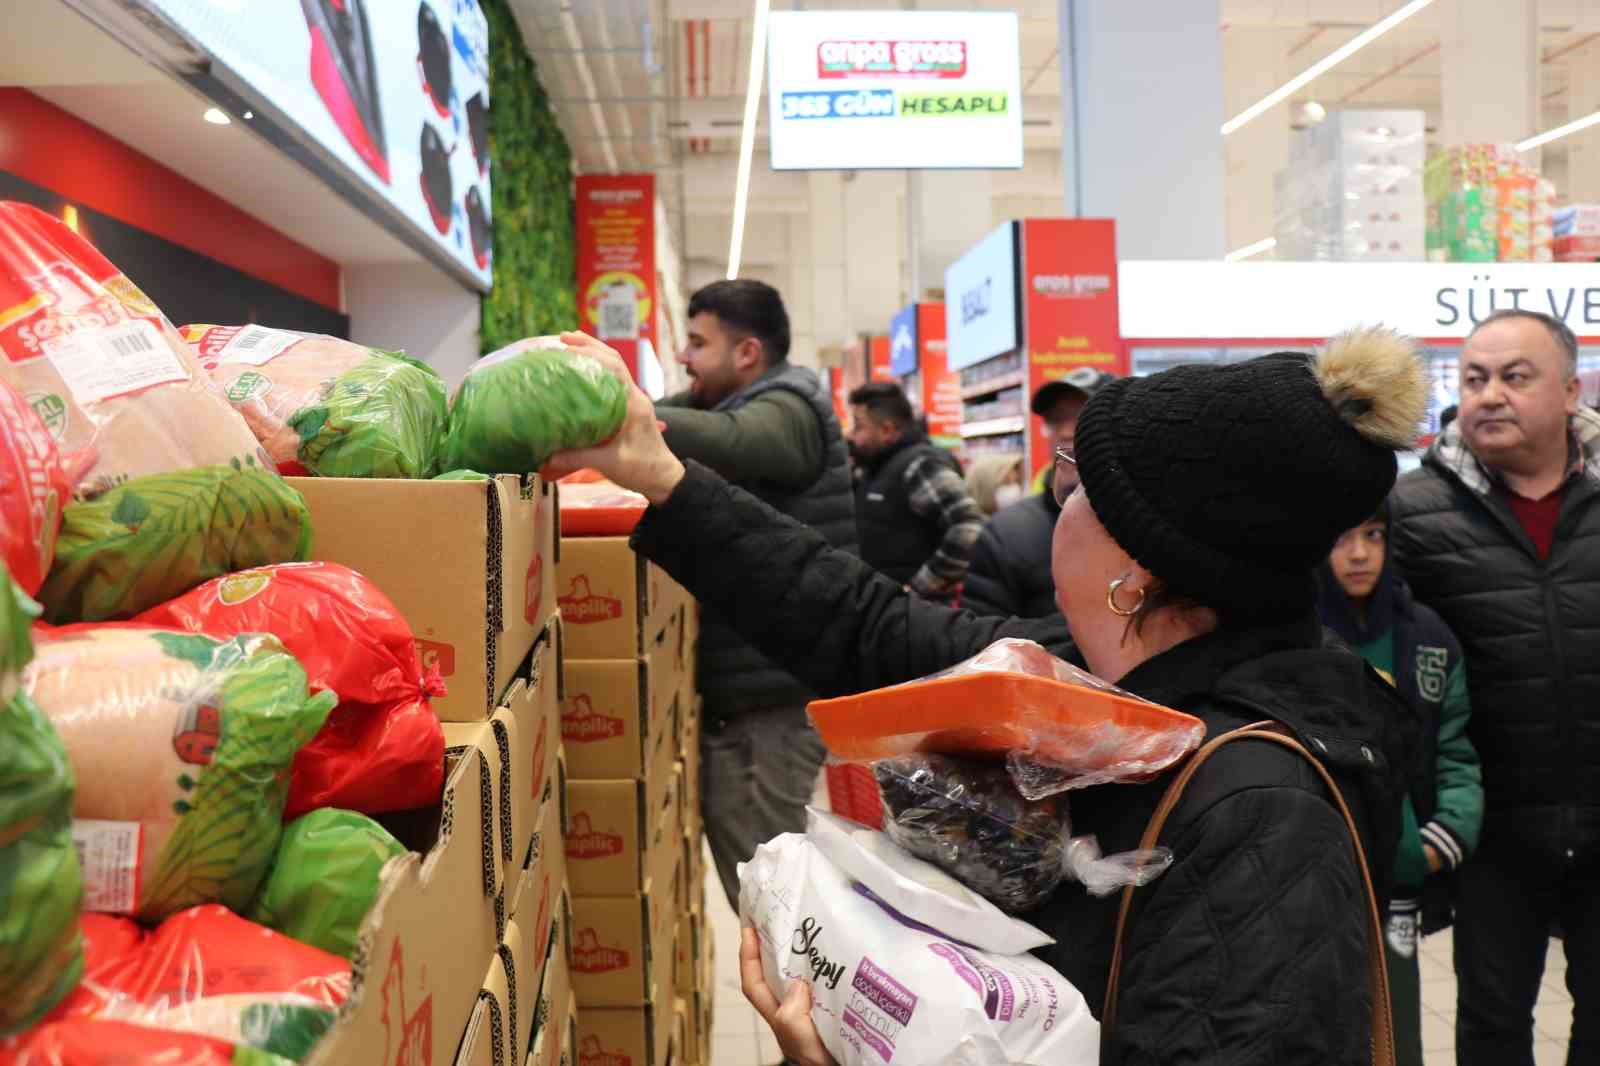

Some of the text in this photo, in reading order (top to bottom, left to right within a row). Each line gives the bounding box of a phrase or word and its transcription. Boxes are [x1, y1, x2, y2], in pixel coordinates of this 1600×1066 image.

[834, 90, 893, 117] GÜN
[901, 96, 1007, 115] HESAPLI
[1435, 275, 1529, 326] SÜT
[791, 916, 847, 991] Sleepy
